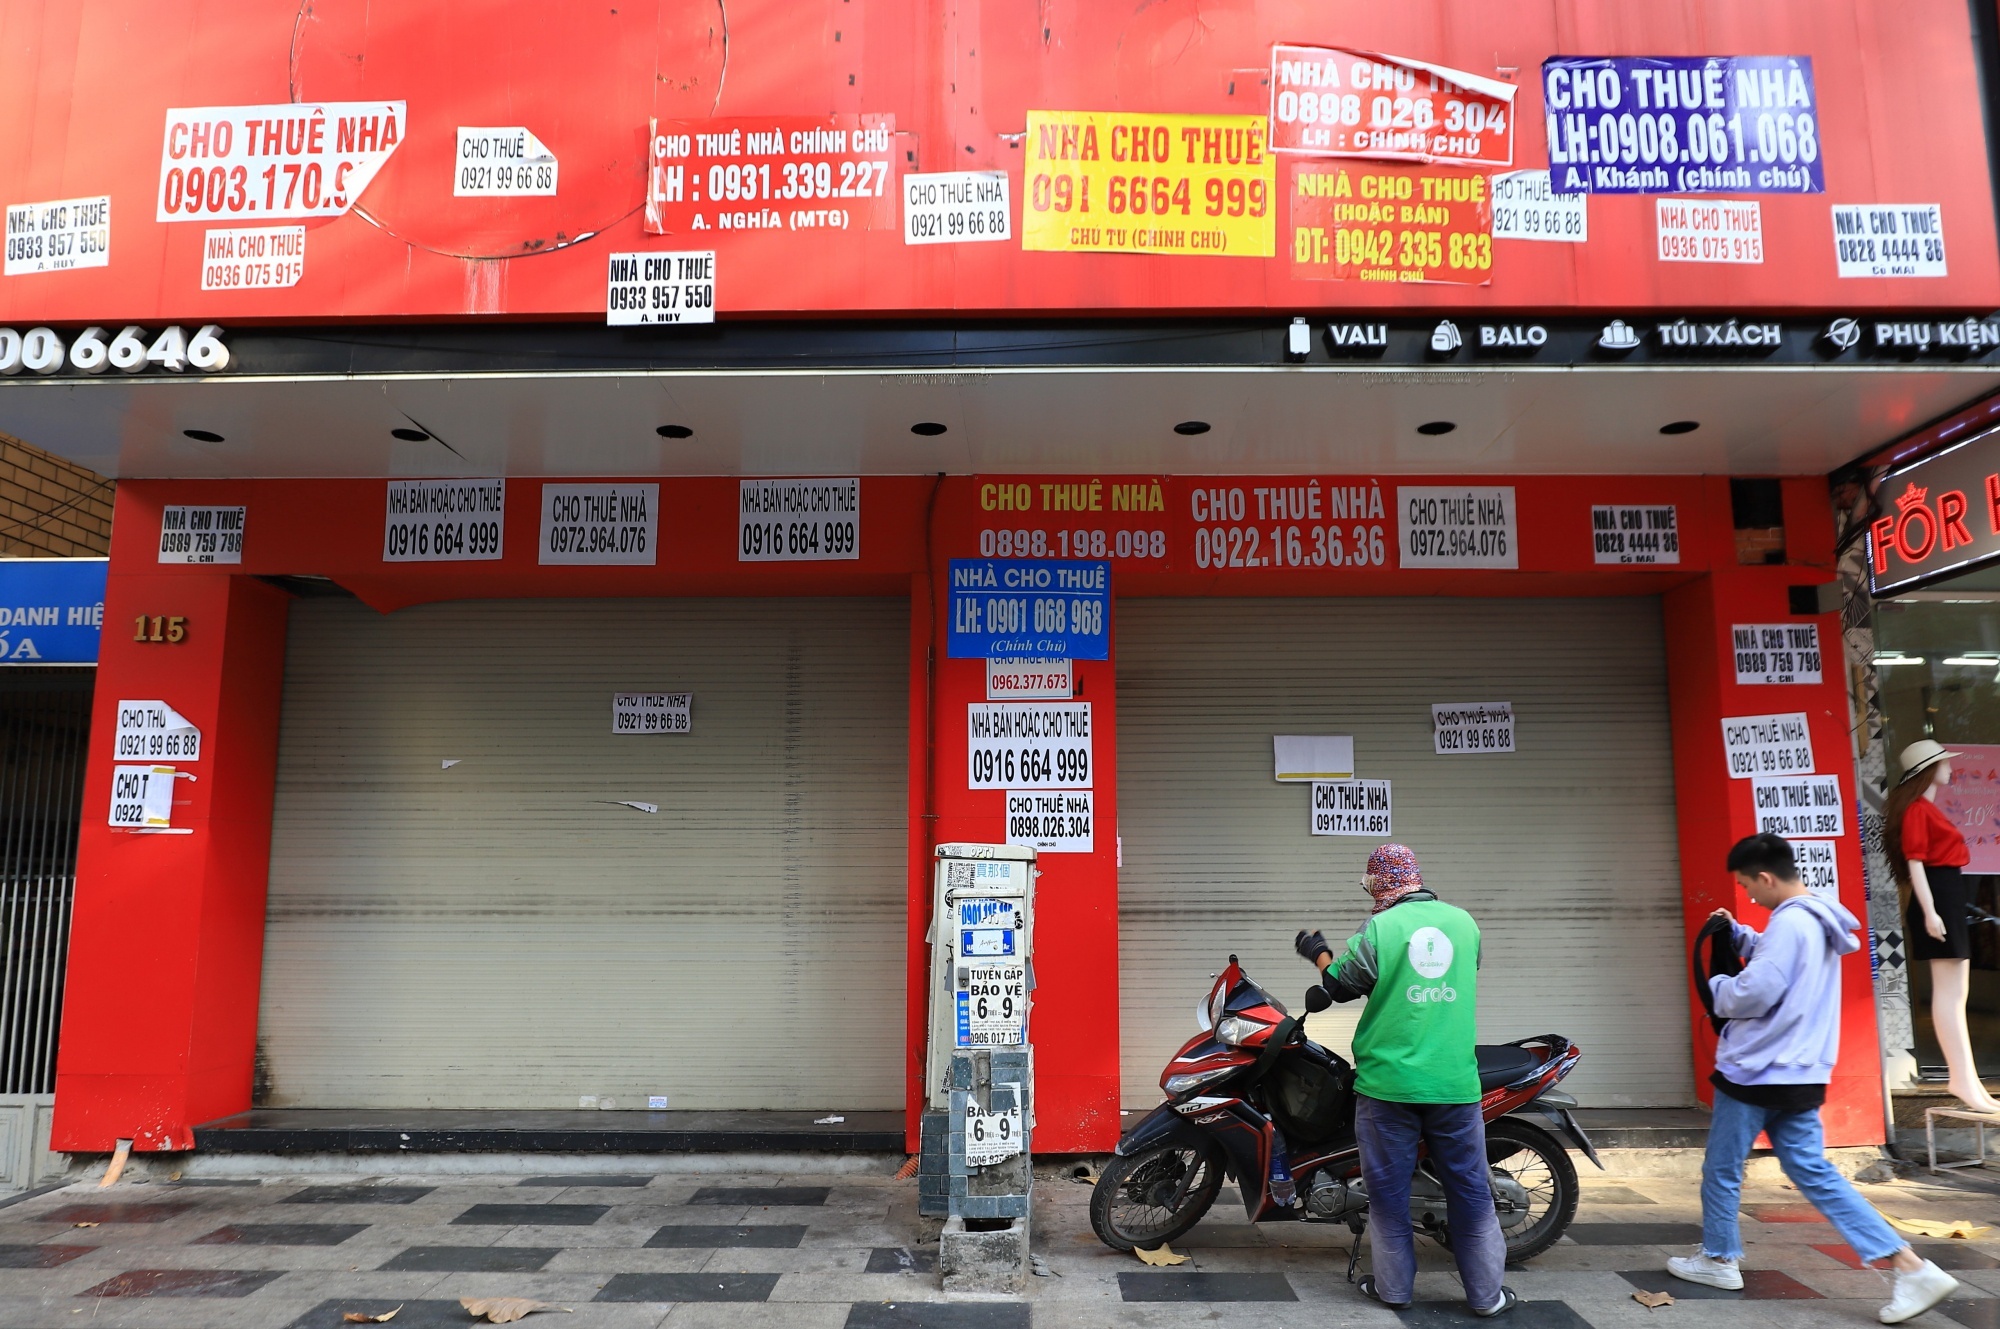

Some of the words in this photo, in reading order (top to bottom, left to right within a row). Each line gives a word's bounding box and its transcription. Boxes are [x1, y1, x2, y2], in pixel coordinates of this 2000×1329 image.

[1281, 58, 1340, 87] NHÀ
[1351, 62, 1416, 91] CHO
[1547, 68, 1622, 110] CHO
[1632, 59, 1726, 109] THUÊ
[1736, 60, 1811, 109] NHÀ
[1278, 91, 1360, 125] 0898
[1372, 96, 1434, 129] 026
[1444, 100, 1506, 135] 304
[168, 121, 232, 159] CHO
[245, 108, 326, 156] THUÊ
[336, 106, 398, 153] NHÀ
[463, 138, 489, 158] CHO
[493, 132, 524, 158] THUÊ
[655, 135, 689, 158] CHO
[698, 129, 740, 157] THUÊ
[746, 128, 784, 156] NHÀ
[790, 127, 847, 155] CHÍNH
[852, 122, 888, 153] CHỦ
[1039, 116, 1099, 162] NHÀ
[1111, 125, 1170, 164] CHO
[1182, 121, 1263, 165] THUÊ
[1302, 129, 1330, 147] LH
[1354, 128, 1426, 149] CHÍNH
[1433, 134, 1481, 155] CHỦ
[461, 166, 491, 189] 0921
[497, 166, 512, 189] 99
[517, 166, 532, 189] 66
[537, 166, 551, 189] 88
[653, 169, 683, 202] LH
[709, 161, 888, 201] 0931.339.227
[1565, 169, 1588, 189] A.
[1596, 166, 1669, 189] Khánh
[1677, 165, 1753, 192] (chính
[1759, 164, 1810, 192] chủ)
[1032, 173, 1089, 213] 091
[1108, 175, 1191, 215] 6664
[1205, 178, 1268, 218] 999
[692, 214, 710, 230] A.
[719, 209, 782, 229] NGHĨA
[790, 209, 849, 230] (MTG)
[1660, 202, 1688, 230] NHÀ
[1692, 208, 1720, 232] CHO
[1723, 205, 1759, 232] THUÊ
[1835, 207, 1865, 234] NHÀ
[1870, 211, 1897, 234] CHO
[1901, 206, 1939, 234] THUÊ
[1132, 228, 1185, 250] (CHÍNH
[1662, 235, 1697, 258] 0936
[1703, 237, 1729, 259] 075
[1734, 238, 1761, 261] 915
[1839, 238, 1877, 262] 0828
[1882, 238, 1920, 262] 4444
[610, 255, 639, 282] NHÀ
[644, 259, 671, 281] CHO
[677, 253, 712, 280] THUÊ
[1891, 265, 1915, 275] MAI
[610, 286, 646, 310] 0933
[652, 286, 678, 309] 957
[685, 285, 712, 308] 550
[658, 313, 681, 322] HUY
[1330, 324, 1388, 346] VALI
[1479, 325, 1548, 346] BALO
[1659, 318, 1702, 346] TÚI
[1705, 316, 1782, 345] XÁCH
[1877, 323, 1931, 350] PHỤ
[1940, 317, 2000, 351] KIỆN
[70, 325, 230, 373] 6646
[389, 481, 408, 514] NHÀ
[410, 481, 428, 513] BÁN
[430, 483, 455, 520] HOẶC
[457, 489, 477, 512] CHO
[478, 480, 501, 512] THUÊ
[552, 496, 580, 521] CHO
[584, 489, 617, 522] THUÊ
[620, 489, 647, 523] NHÀ
[980, 483, 1031, 511] CHO
[1040, 479, 1102, 512] THUÊ
[1112, 479, 1165, 511] NHÀ
[1190, 488, 1246, 523] CHO
[1253, 478, 1322, 521] THUÊ
[1331, 478, 1386, 520] NHÀ
[165, 508, 186, 530] NHÀ
[190, 511, 212, 530] CHO
[215, 507, 243, 531] THUÊ
[162, 533, 190, 553] 0989
[195, 533, 216, 553] 759
[220, 533, 242, 553] 798
[388, 523, 428, 556] 0916
[433, 522, 464, 554] 664
[469, 522, 498, 554] 999
[550, 526, 646, 553] 0972.964.076
[980, 529, 1165, 558] 0898.198.098
[1195, 524, 1386, 569] 0922.16.36.36
[199, 555, 214, 563] CHI
[954, 563, 998, 587] NHÀ
[1004, 568, 1051, 588] CHO
[1057, 565, 1105, 589] THUÊ
[0, 607, 59, 626] DANH
[133, 614, 186, 642] 115
[955, 597, 981, 634] LH:
[987, 598, 1026, 634] 0901
[1034, 598, 1066, 634] 068
[1071, 599, 1103, 635] 968
[991, 636, 1033, 653] (Chính
[1036, 638, 1067, 653] Chủ)
[992, 674, 1068, 690] 0962.377.673
[1727, 725, 1750, 746] CHO
[1751, 719, 1780, 744] THUÊ
[1782, 717, 1807, 742] NHÀ
[1732, 751, 1758, 774] 0921
[1762, 750, 1776, 771] 99
[1778, 749, 1793, 770] 66
[1796, 747, 1811, 768] 88
[1009, 797, 1033, 814] CHO
[1035, 793, 1063, 814] THUÊ
[1067, 794, 1090, 814] NHÀ
[1315, 785, 1335, 809] CHO
[1338, 781, 1365, 810] THUÊ
[1367, 782, 1388, 810] NHÀ
[1010, 816, 1090, 838] 0898.026.304
[1317, 814, 1389, 832] 0917.111.661
[1809, 843, 1832, 863] NHÀ
[962, 903, 982, 925] 0901
[971, 965, 1001, 980] TUYỂN
[1004, 966, 1023, 980] GẤP
[971, 981, 1000, 996] BẢO
[1005, 982, 1023, 998] VỆ
[1407, 982, 1456, 1003] Grab
[977, 997, 988, 1019] 6
[1002, 997, 1013, 1019] 9
[992, 1033, 1005, 1043] 017
[974, 1119, 984, 1141] 6
[999, 1118, 1010, 1140] 9
